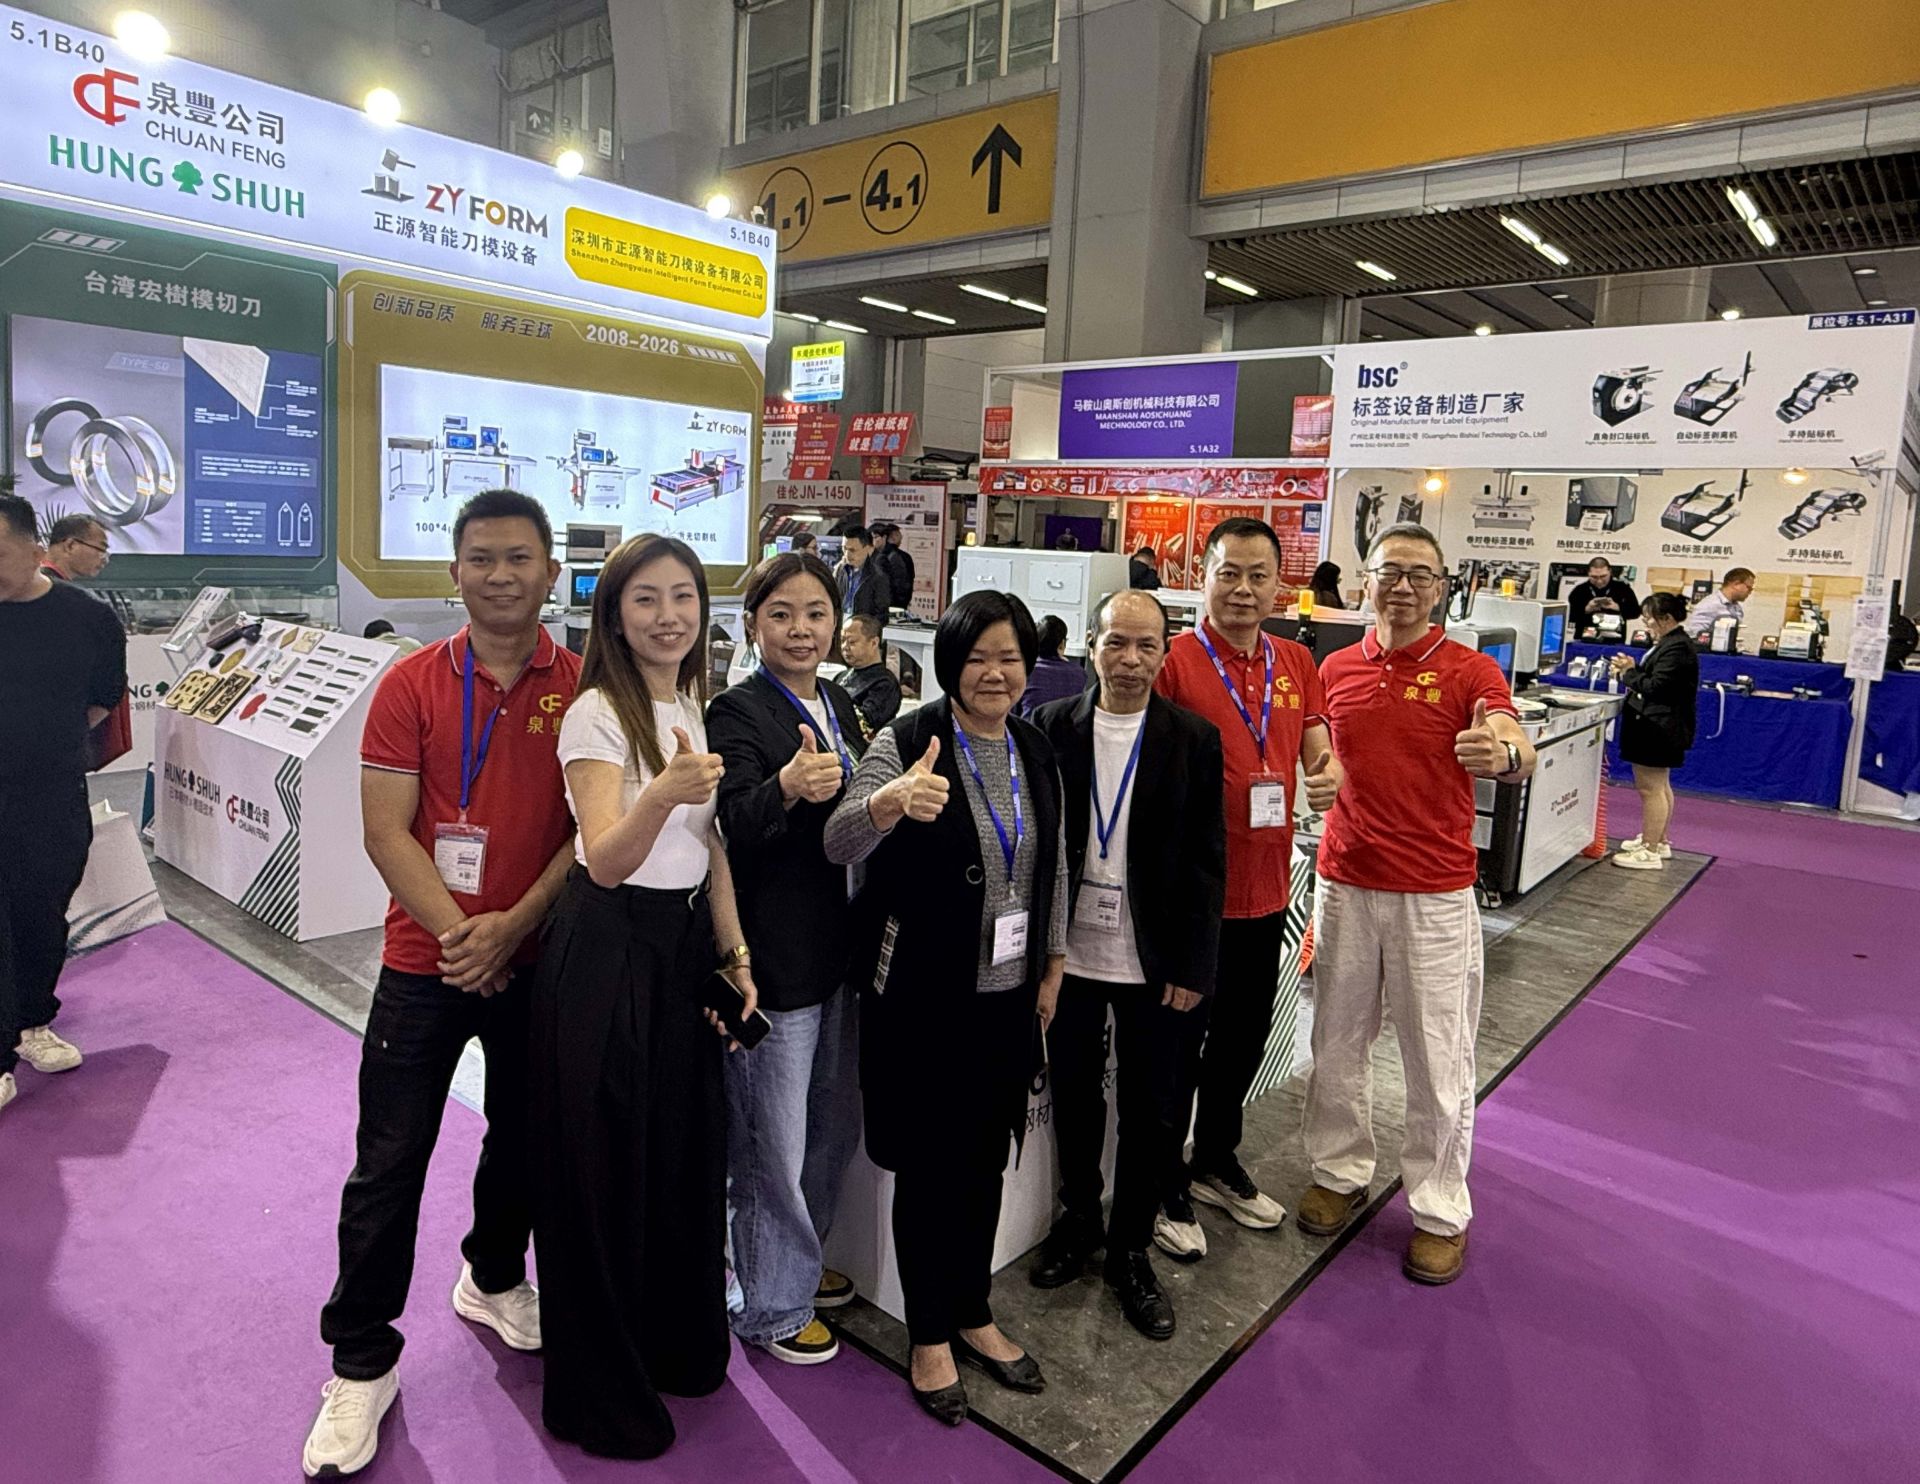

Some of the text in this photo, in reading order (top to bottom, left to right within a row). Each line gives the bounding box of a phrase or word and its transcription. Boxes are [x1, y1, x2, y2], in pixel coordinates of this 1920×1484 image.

[10, 20, 105, 63] 5.1B40
[147, 81, 284, 145] 泉豐公司
[146, 120, 286, 169] CHUAN FENG
[50, 135, 305, 218] HUNG SHUH
[865, 168, 921, 212] 4.1
[426, 183, 548, 239] ZY FORM
[374, 211, 538, 266] 正源智能刀模设备
[730, 227, 770, 248] 5.1B40
[571, 248, 609, 265] Shenzhen
[571, 228, 764, 290] 深圳市正源智能刀模设备有限公司
[85, 270, 261, 317] 台湾宏樹模切刀
[373, 292, 554, 340] 创新品质 服务全球
[1856, 312, 1908, 325] 5.1-A31
[586, 325, 680, 356] 2008-2026
[1357, 364, 1399, 389] bsc
[1073, 394, 1220, 412] 马鞍山奥斯创机械科技有限公司
[1095, 410, 1193, 421] MAANSHAN AOSICHUANG
[1352, 392, 1526, 417] 标签设备制造厂家
[720, 423, 747, 437] FORM
[1099, 420, 1152, 430] MECHNOLOGY
[1350, 415, 1510, 428] Original Manufacturer for Label Equipment
[1787, 429, 1836, 439] 手持贴标机
[1556, 539, 1631, 551] 热转印工业打印机
[1661, 543, 1734, 555] 自动标签剥离机
[1786, 548, 1845, 560] 手持贴标机
[164, 760, 222, 805] HUNG SHUH
